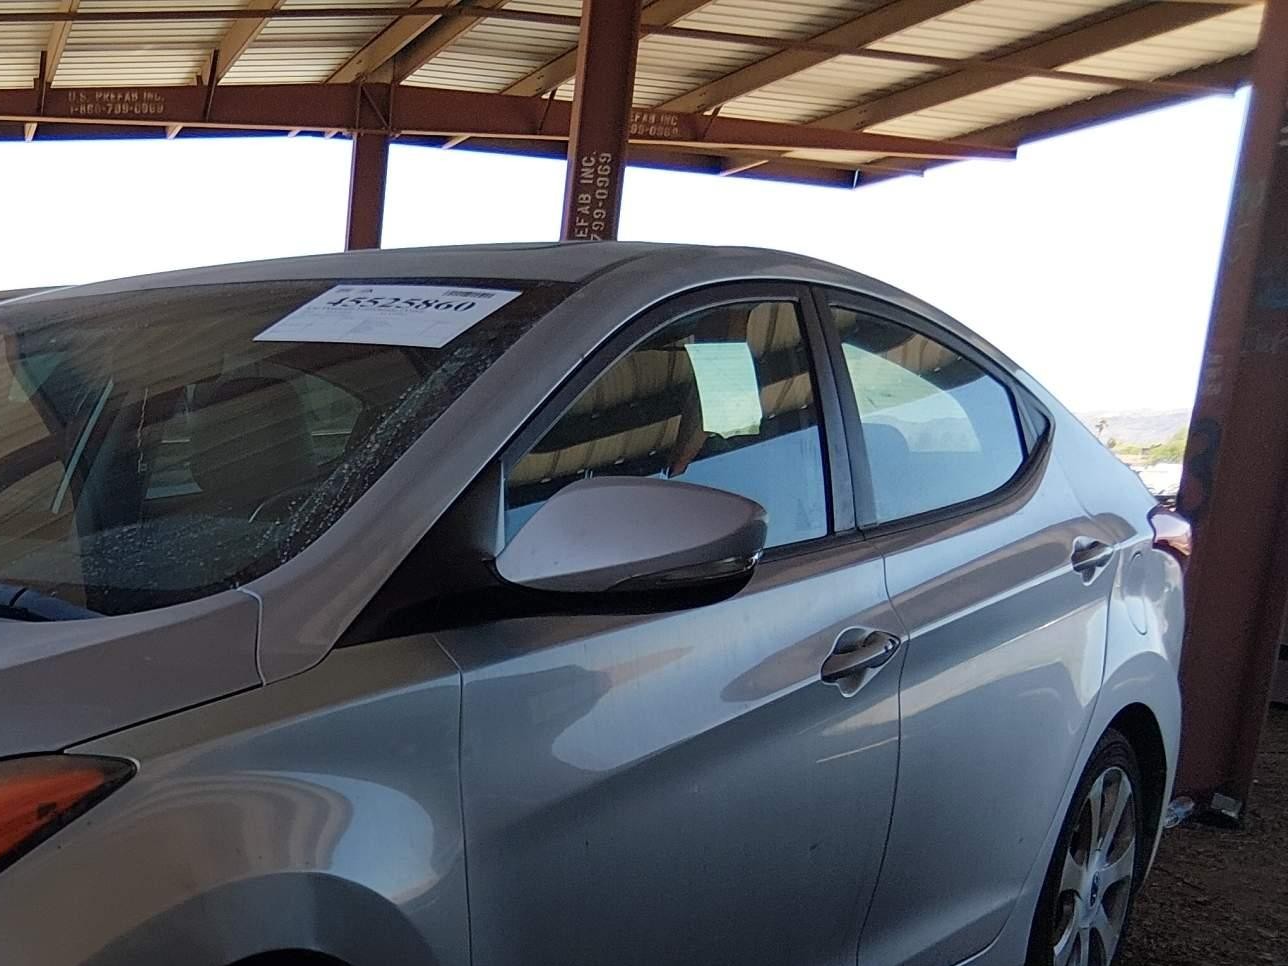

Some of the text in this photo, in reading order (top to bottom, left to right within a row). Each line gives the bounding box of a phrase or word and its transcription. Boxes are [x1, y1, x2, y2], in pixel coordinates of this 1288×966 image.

[95, 91, 138, 102] PREFAB
[575, 151, 596, 238] EFAB INC.
[327, 296, 476, 312] 45525860
